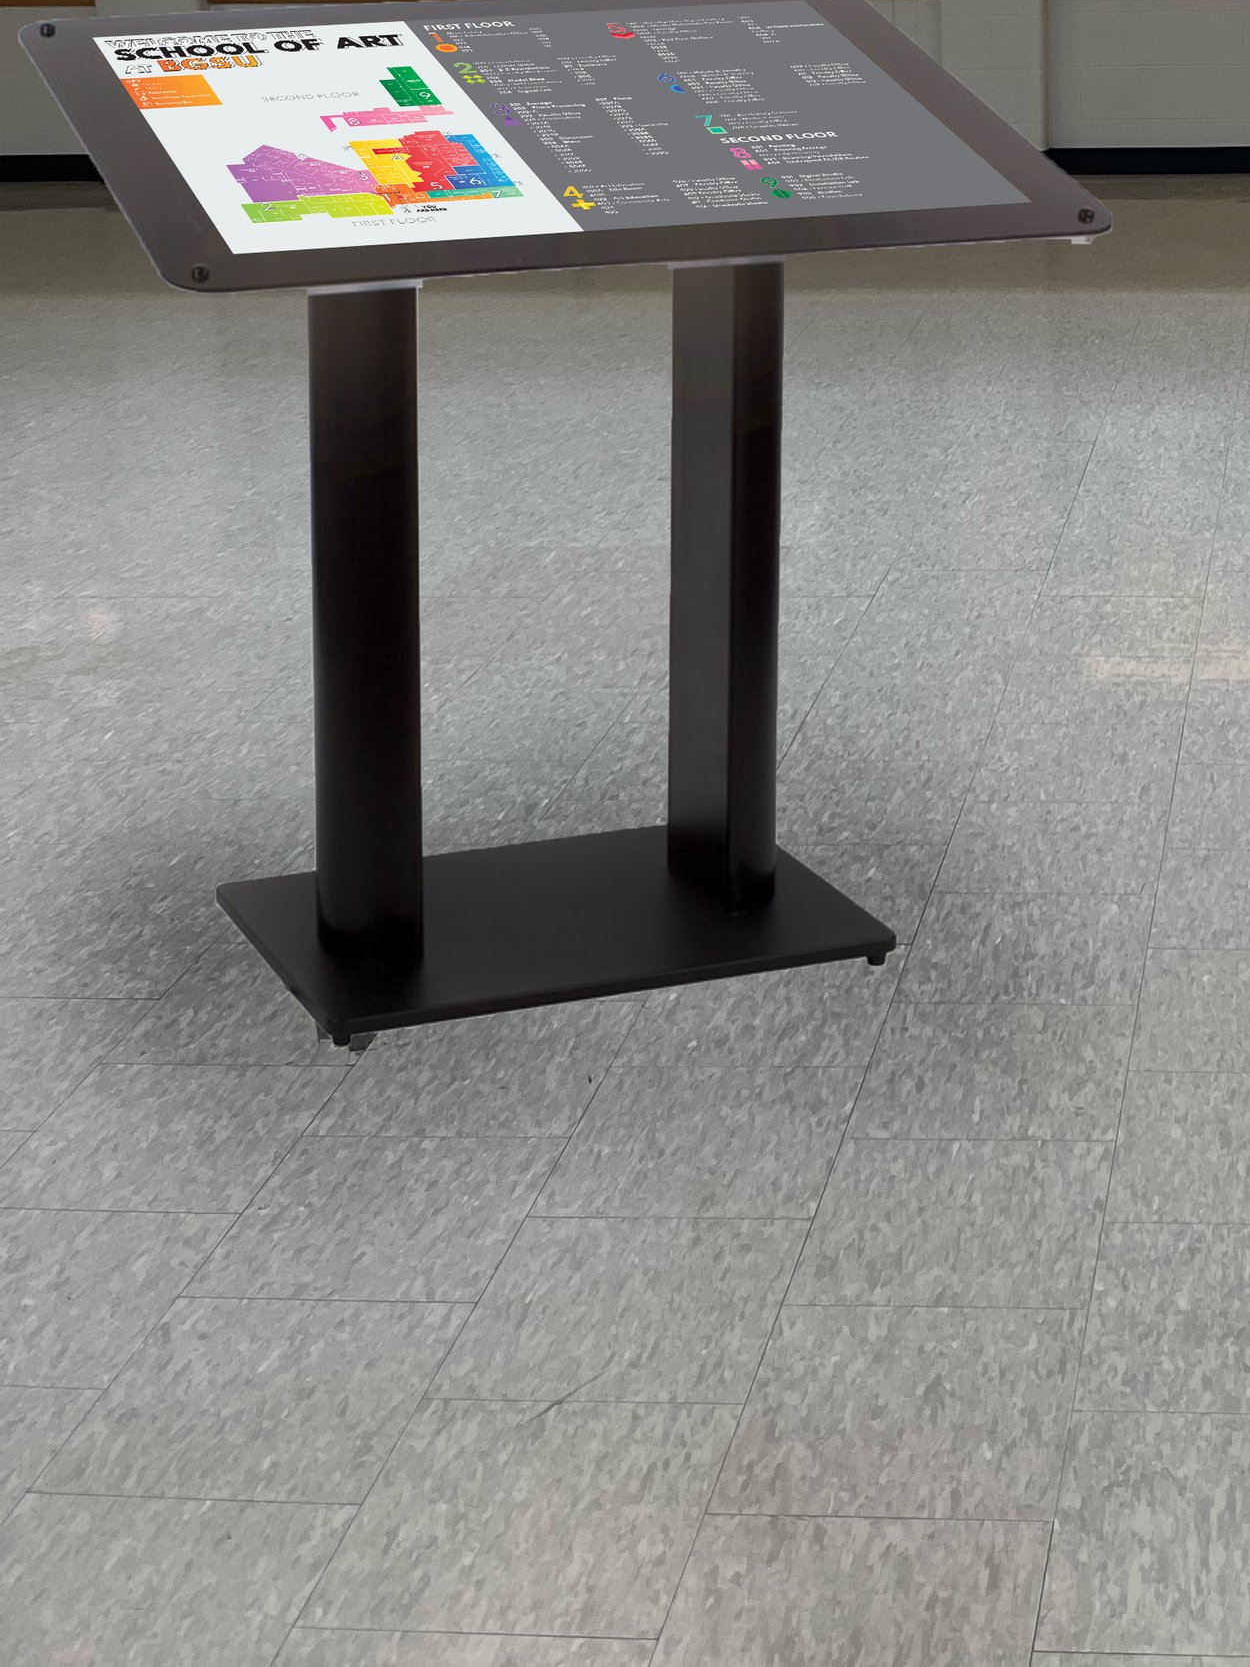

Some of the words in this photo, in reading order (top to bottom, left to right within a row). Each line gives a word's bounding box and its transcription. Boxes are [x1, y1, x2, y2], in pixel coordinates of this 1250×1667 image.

[423, 23, 461, 31] FIRST
[464, 21, 515, 30] FLOOR
[105, 34, 233, 49] WELCOME
[231, 32, 268, 43] TO
[266, 30, 316, 41] THE
[114, 42, 269, 61] SCHOOL
[273, 37, 323, 52] OF
[337, 34, 404, 49] ART
[125, 64, 152, 75] AT
[157, 54, 262, 73] BGSU
[453, 62, 478, 74] 2
[261, 93, 315, 103] SECOND
[317, 91, 361, 100] FLOOR
[720, 134, 784, 144] SECOND
[785, 131, 839, 140] FLOOR
[430, 182, 443, 190] 5
[563, 185, 584, 198] 4
[352, 219, 386, 228] FIRST
[389, 216, 438, 225] FLOOR
